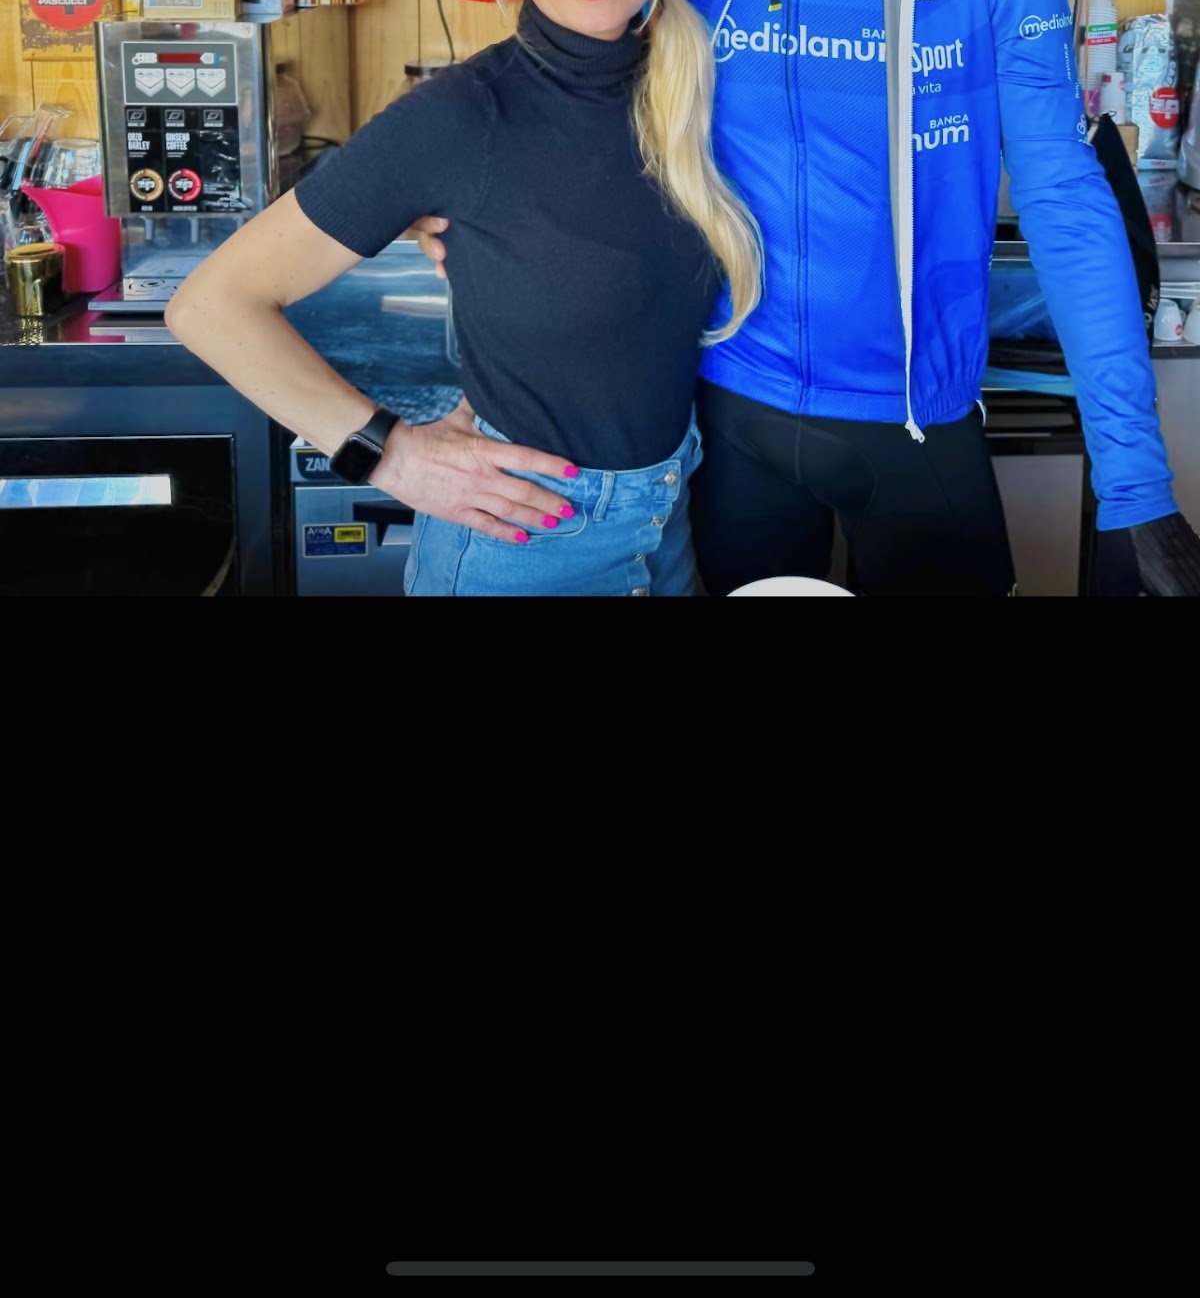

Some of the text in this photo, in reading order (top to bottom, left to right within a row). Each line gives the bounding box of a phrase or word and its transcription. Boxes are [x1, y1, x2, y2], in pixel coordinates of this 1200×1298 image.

[911, 38, 965, 78] Sport
[918, 81, 942, 94] vita
[929, 113, 970, 129] BANCA
[127, 132, 143, 142] ORZO
[165, 132, 191, 142] GINSENG
[128, 141, 151, 151] BARLEY
[165, 141, 188, 151] COFFEE
